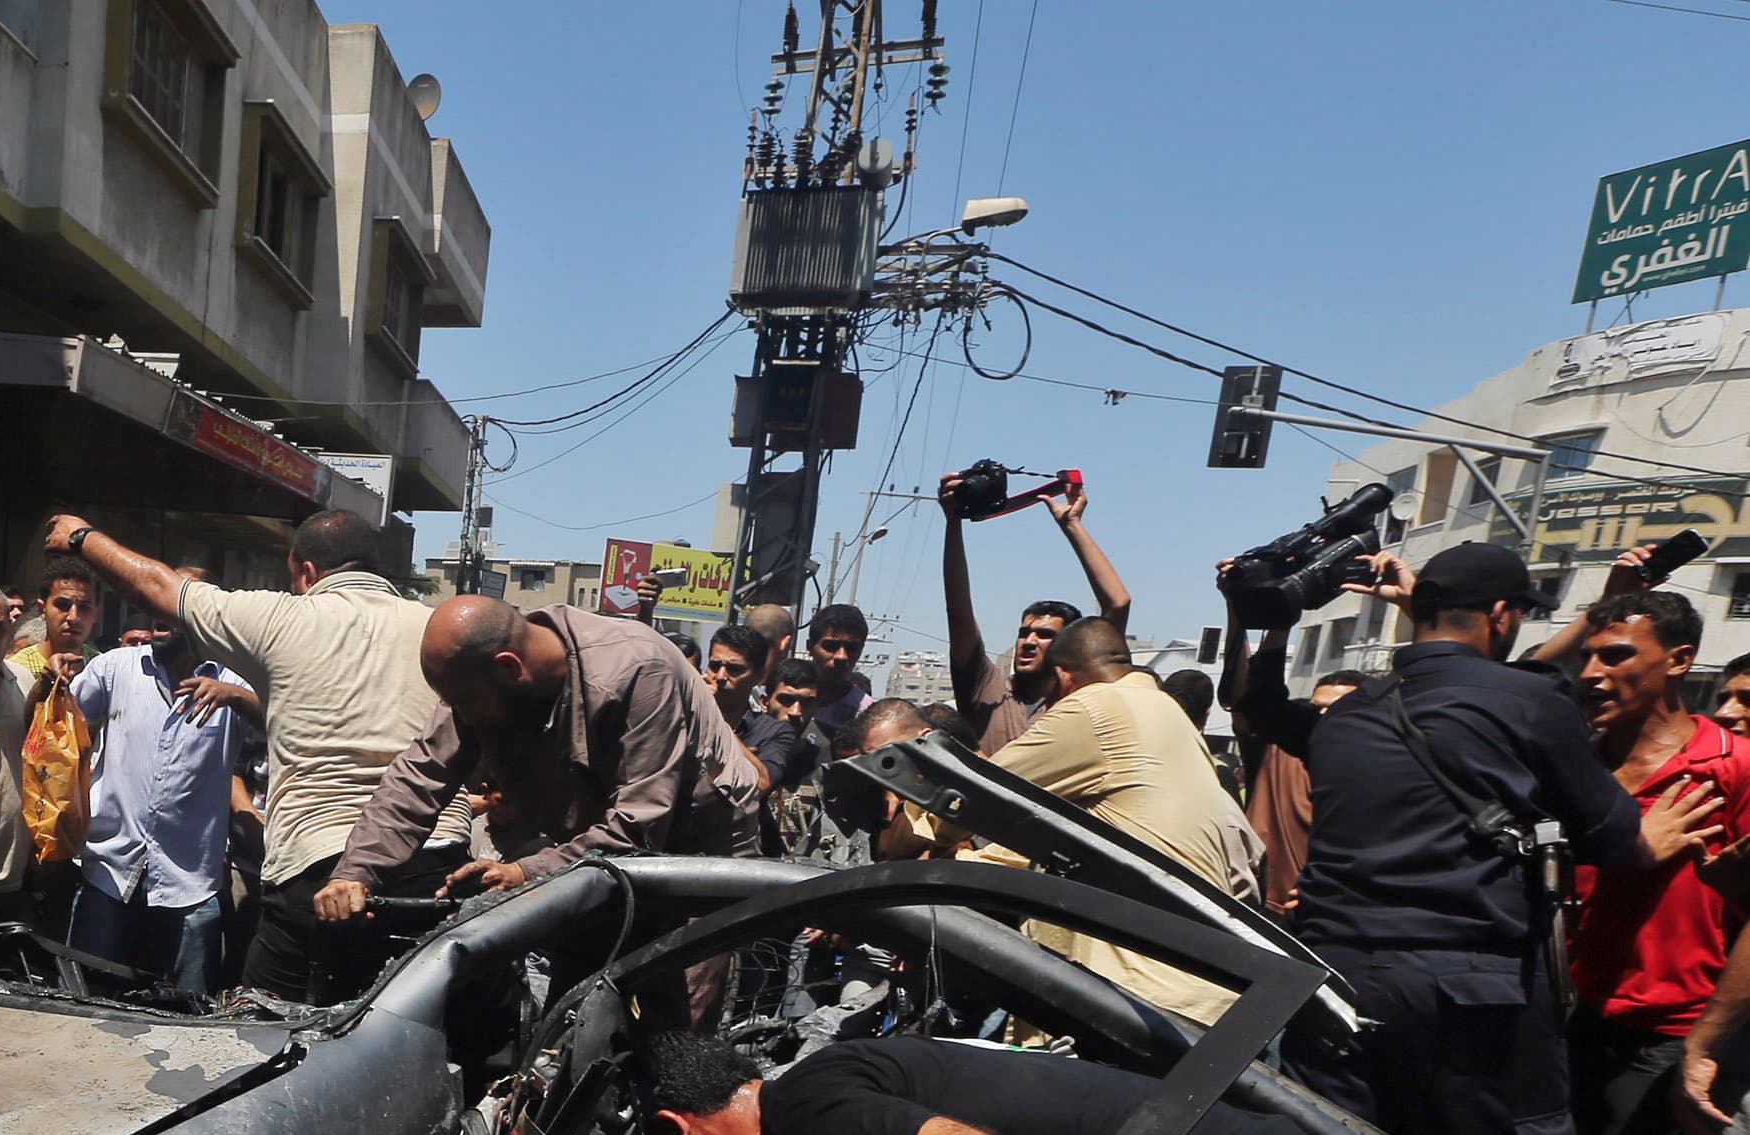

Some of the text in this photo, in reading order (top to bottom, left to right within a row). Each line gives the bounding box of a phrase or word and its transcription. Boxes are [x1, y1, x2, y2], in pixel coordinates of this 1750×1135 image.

[1596, 223, 1655, 245] حمامات
[1656, 205, 1706, 237] أطقم
[1600, 224, 1731, 294] الغفري
